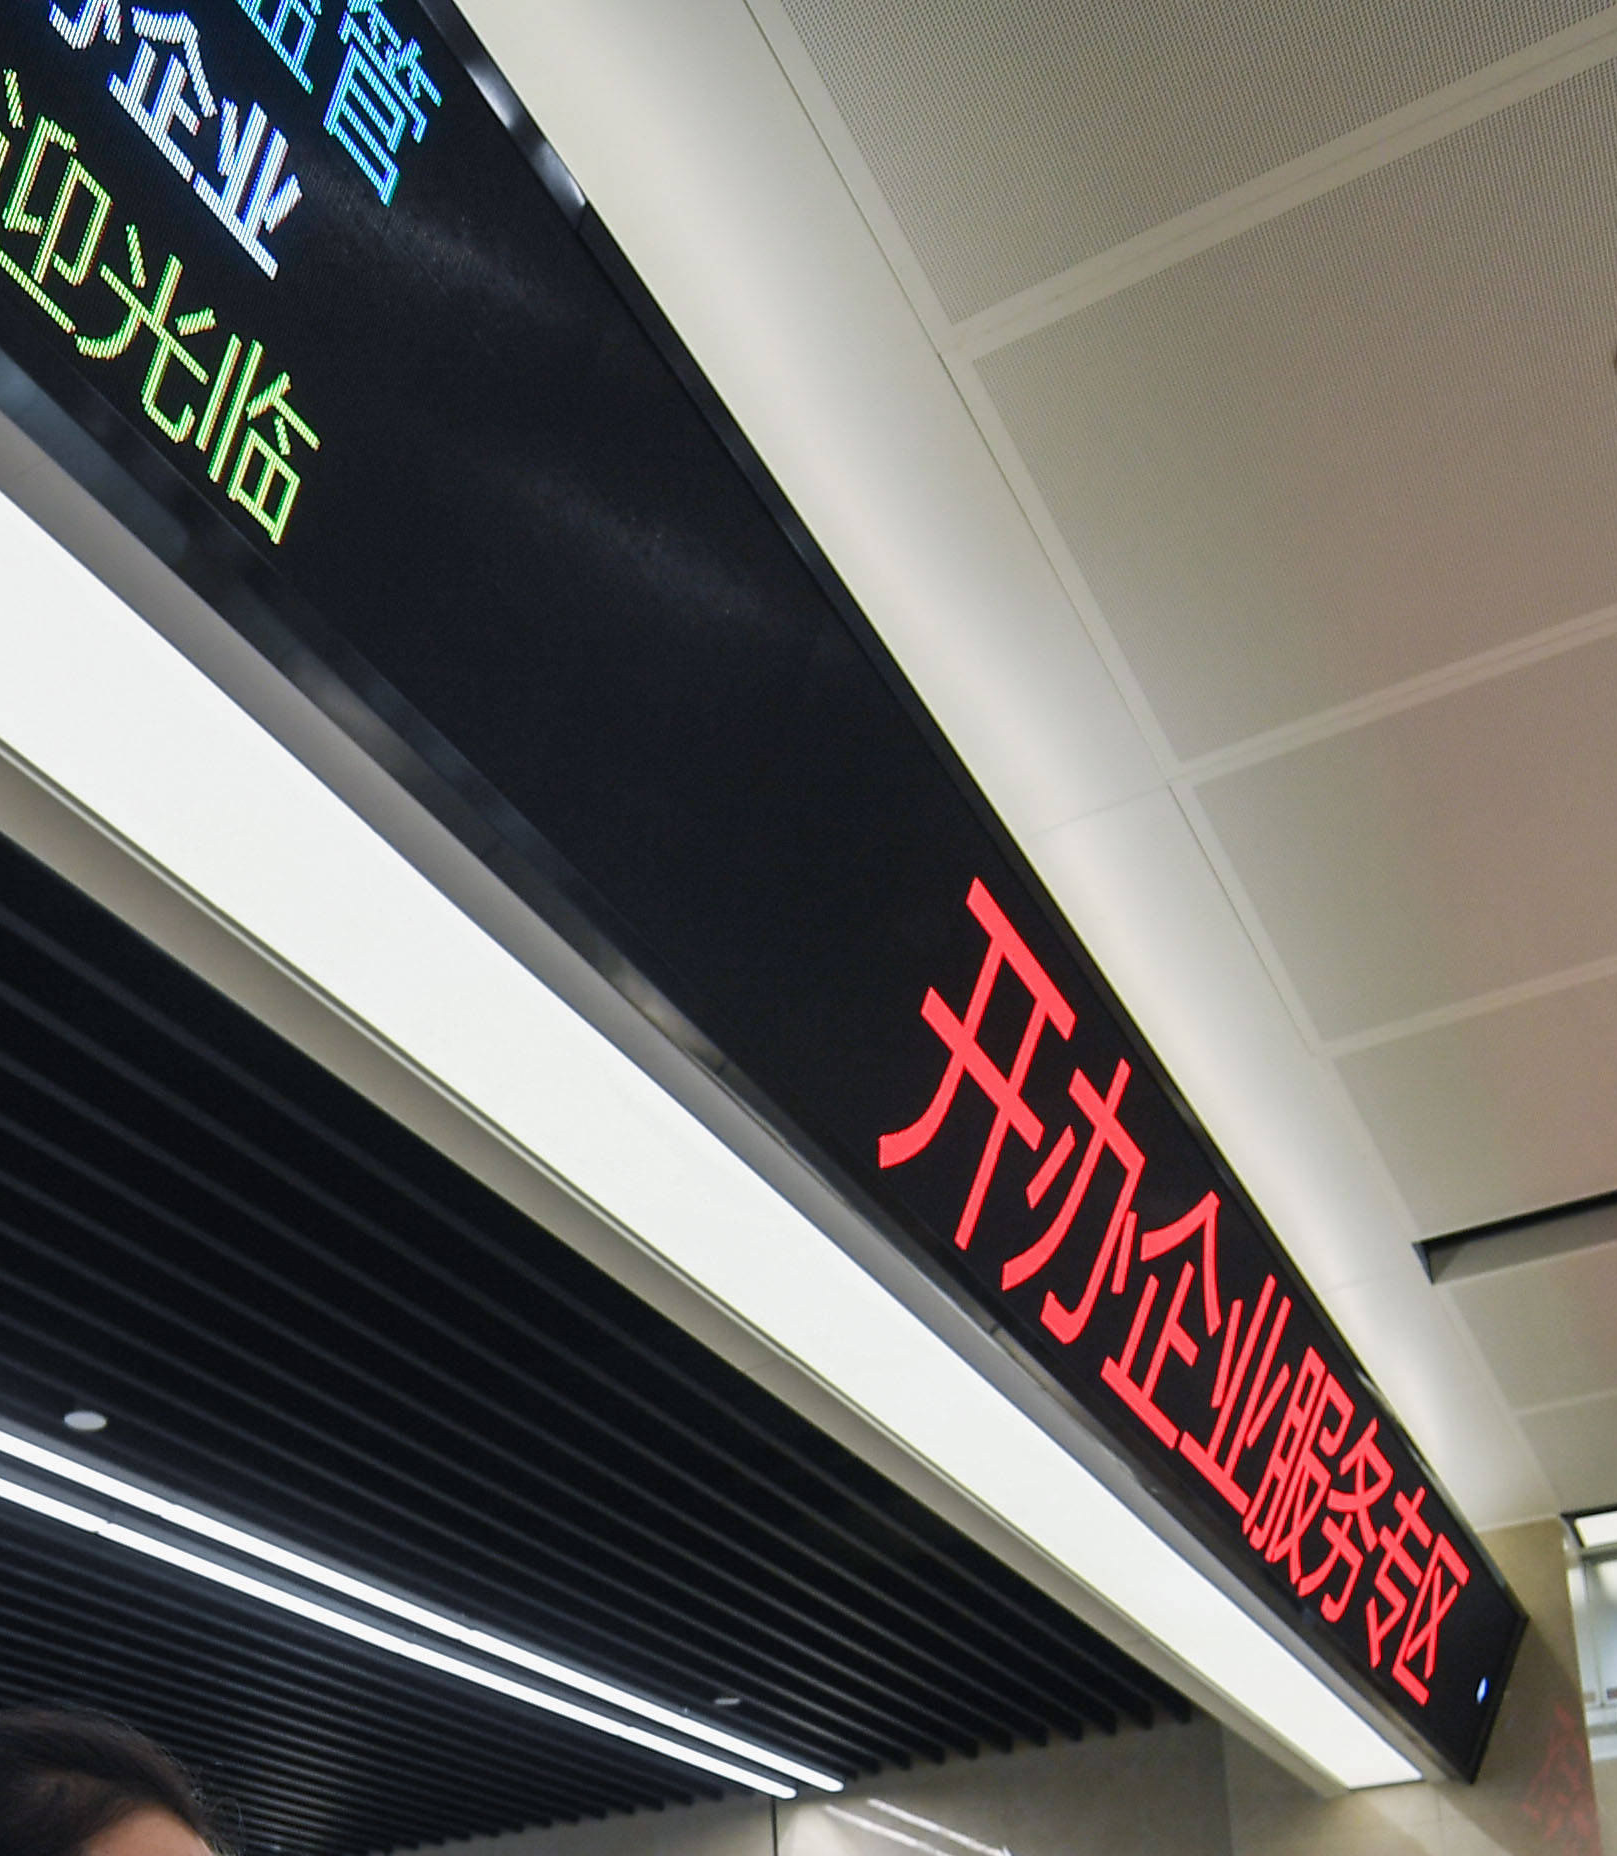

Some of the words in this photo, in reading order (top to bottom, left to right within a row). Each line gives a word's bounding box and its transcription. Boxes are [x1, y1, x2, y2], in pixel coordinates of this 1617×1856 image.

[877, 876, 1470, 1706] 开办企业服务专区
